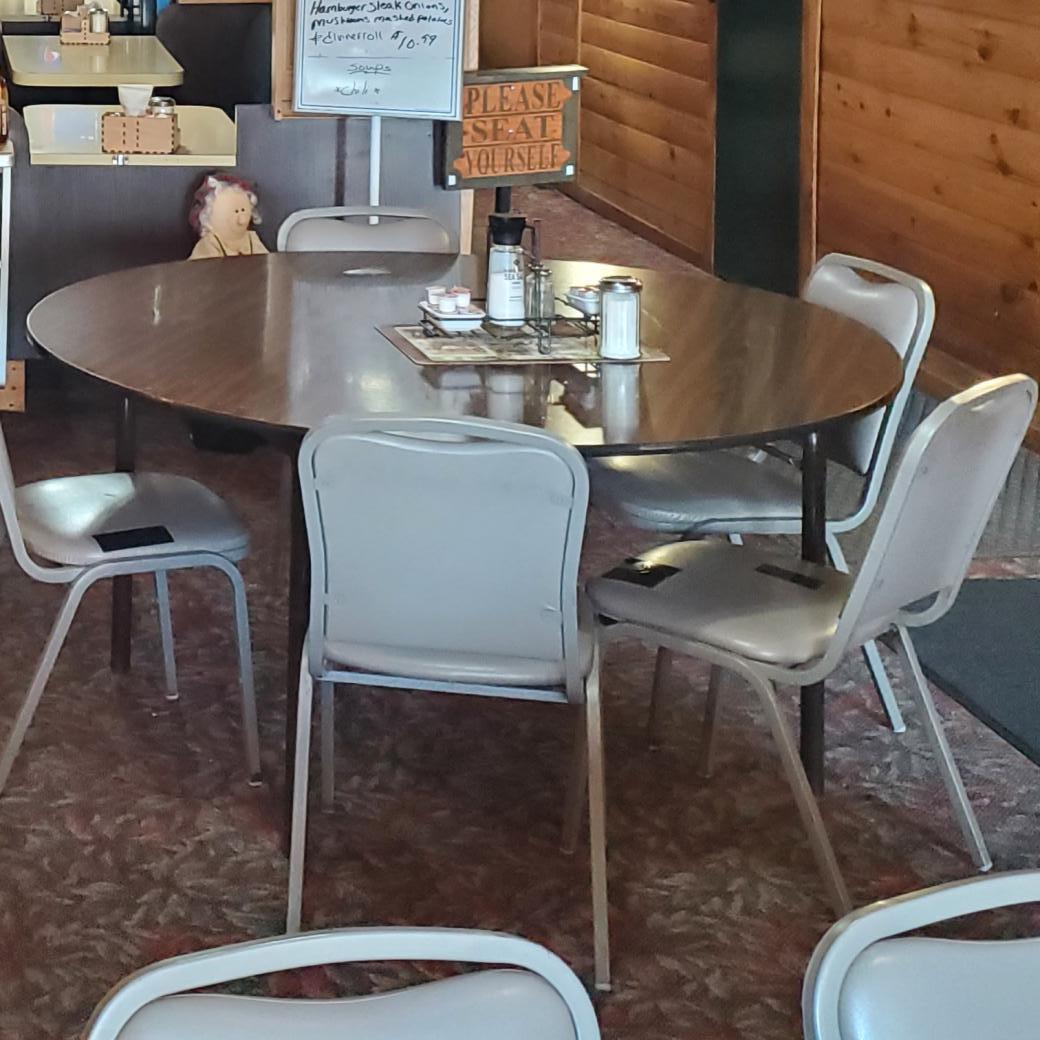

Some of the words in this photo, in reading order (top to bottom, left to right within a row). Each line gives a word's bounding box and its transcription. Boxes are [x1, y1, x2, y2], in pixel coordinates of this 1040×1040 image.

[466, 81, 560, 115] PLEASE
[472, 115, 554, 143] SEAT
[465, 143, 560, 175] YOURSELF
